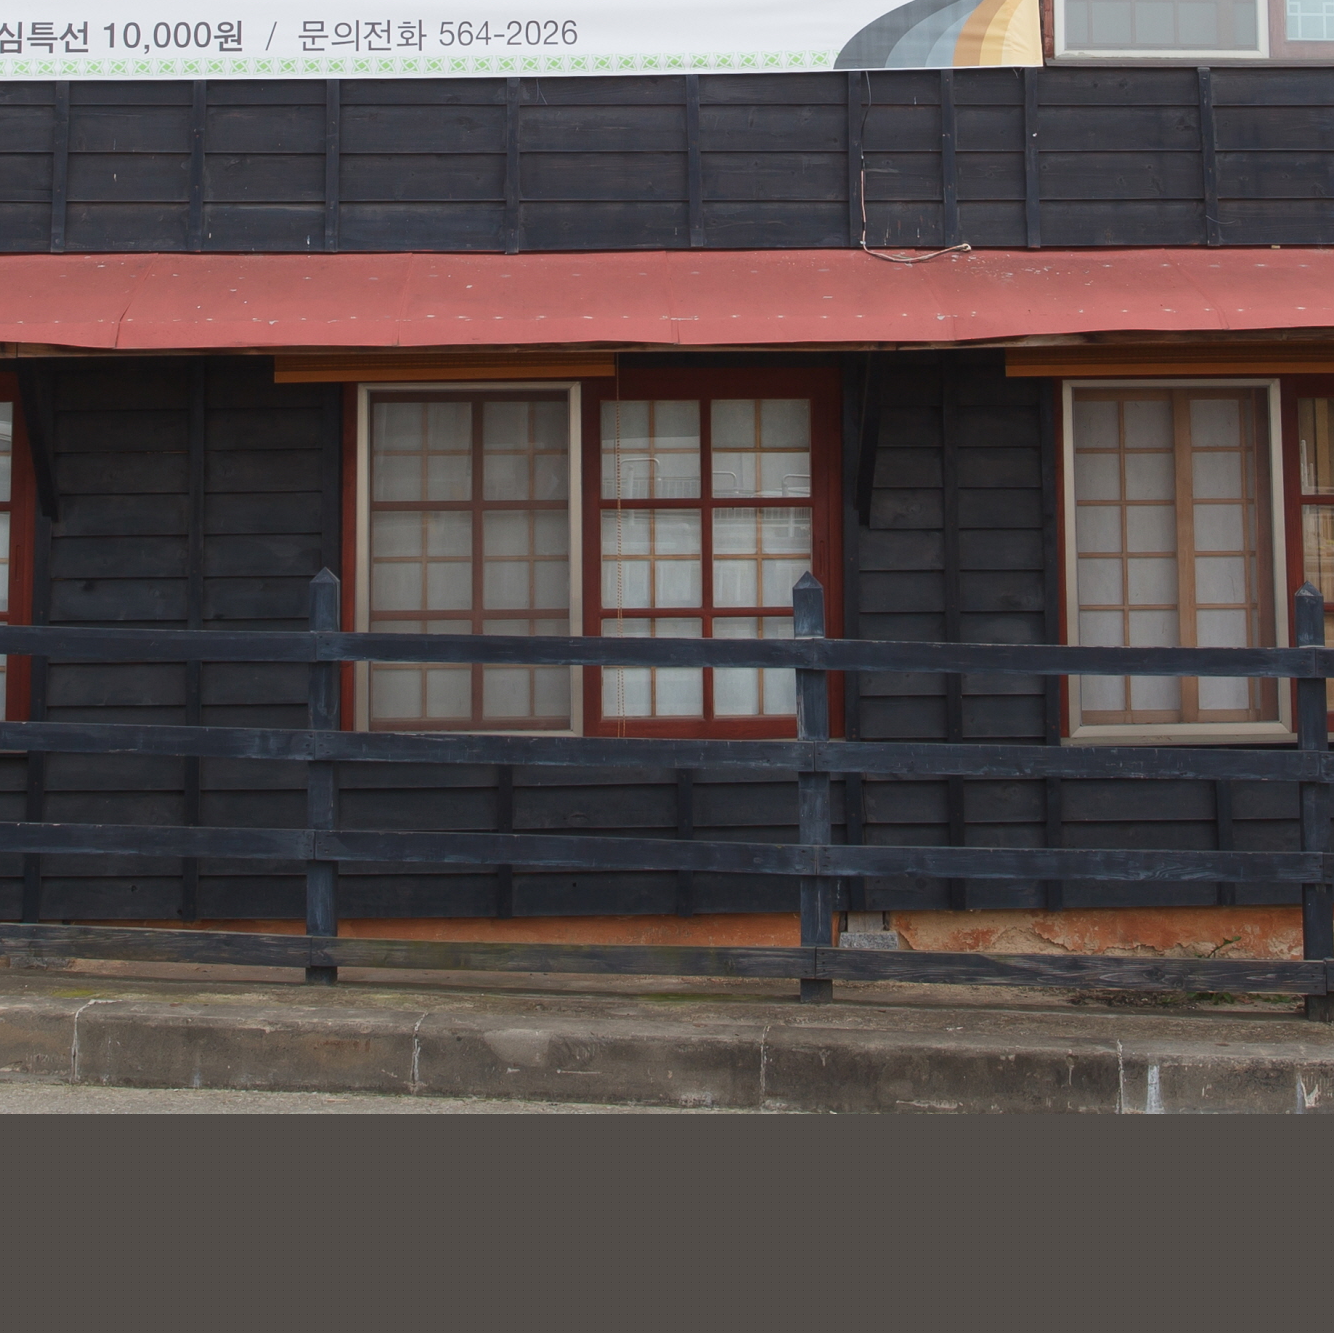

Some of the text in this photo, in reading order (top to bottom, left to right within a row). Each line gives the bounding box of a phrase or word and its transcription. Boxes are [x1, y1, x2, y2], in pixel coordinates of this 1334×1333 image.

[103, 19, 244, 55] 10,000원
[298, 19, 427, 53] 문의전화
[439, 19, 579, 47] 564-2026
